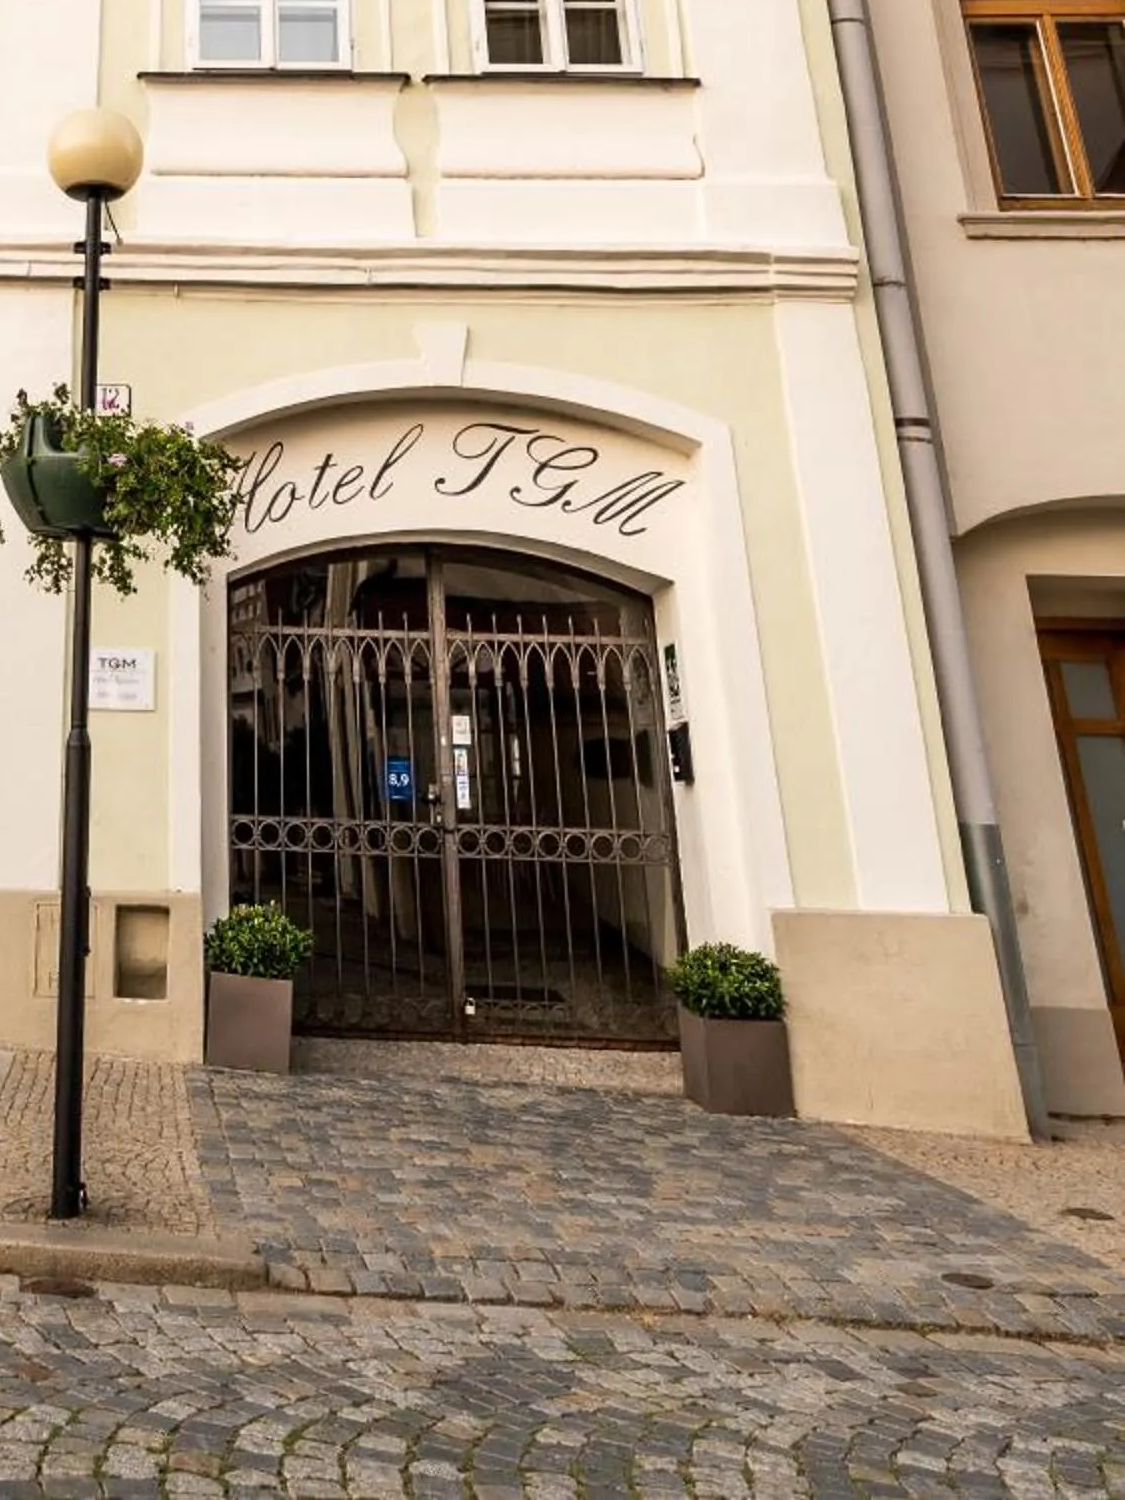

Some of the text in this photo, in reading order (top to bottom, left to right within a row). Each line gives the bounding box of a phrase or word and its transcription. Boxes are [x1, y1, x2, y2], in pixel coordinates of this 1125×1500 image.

[434, 423, 685, 537] TGM
[97, 657, 137, 670] TGM
[388, 773, 410, 788] 8,9
